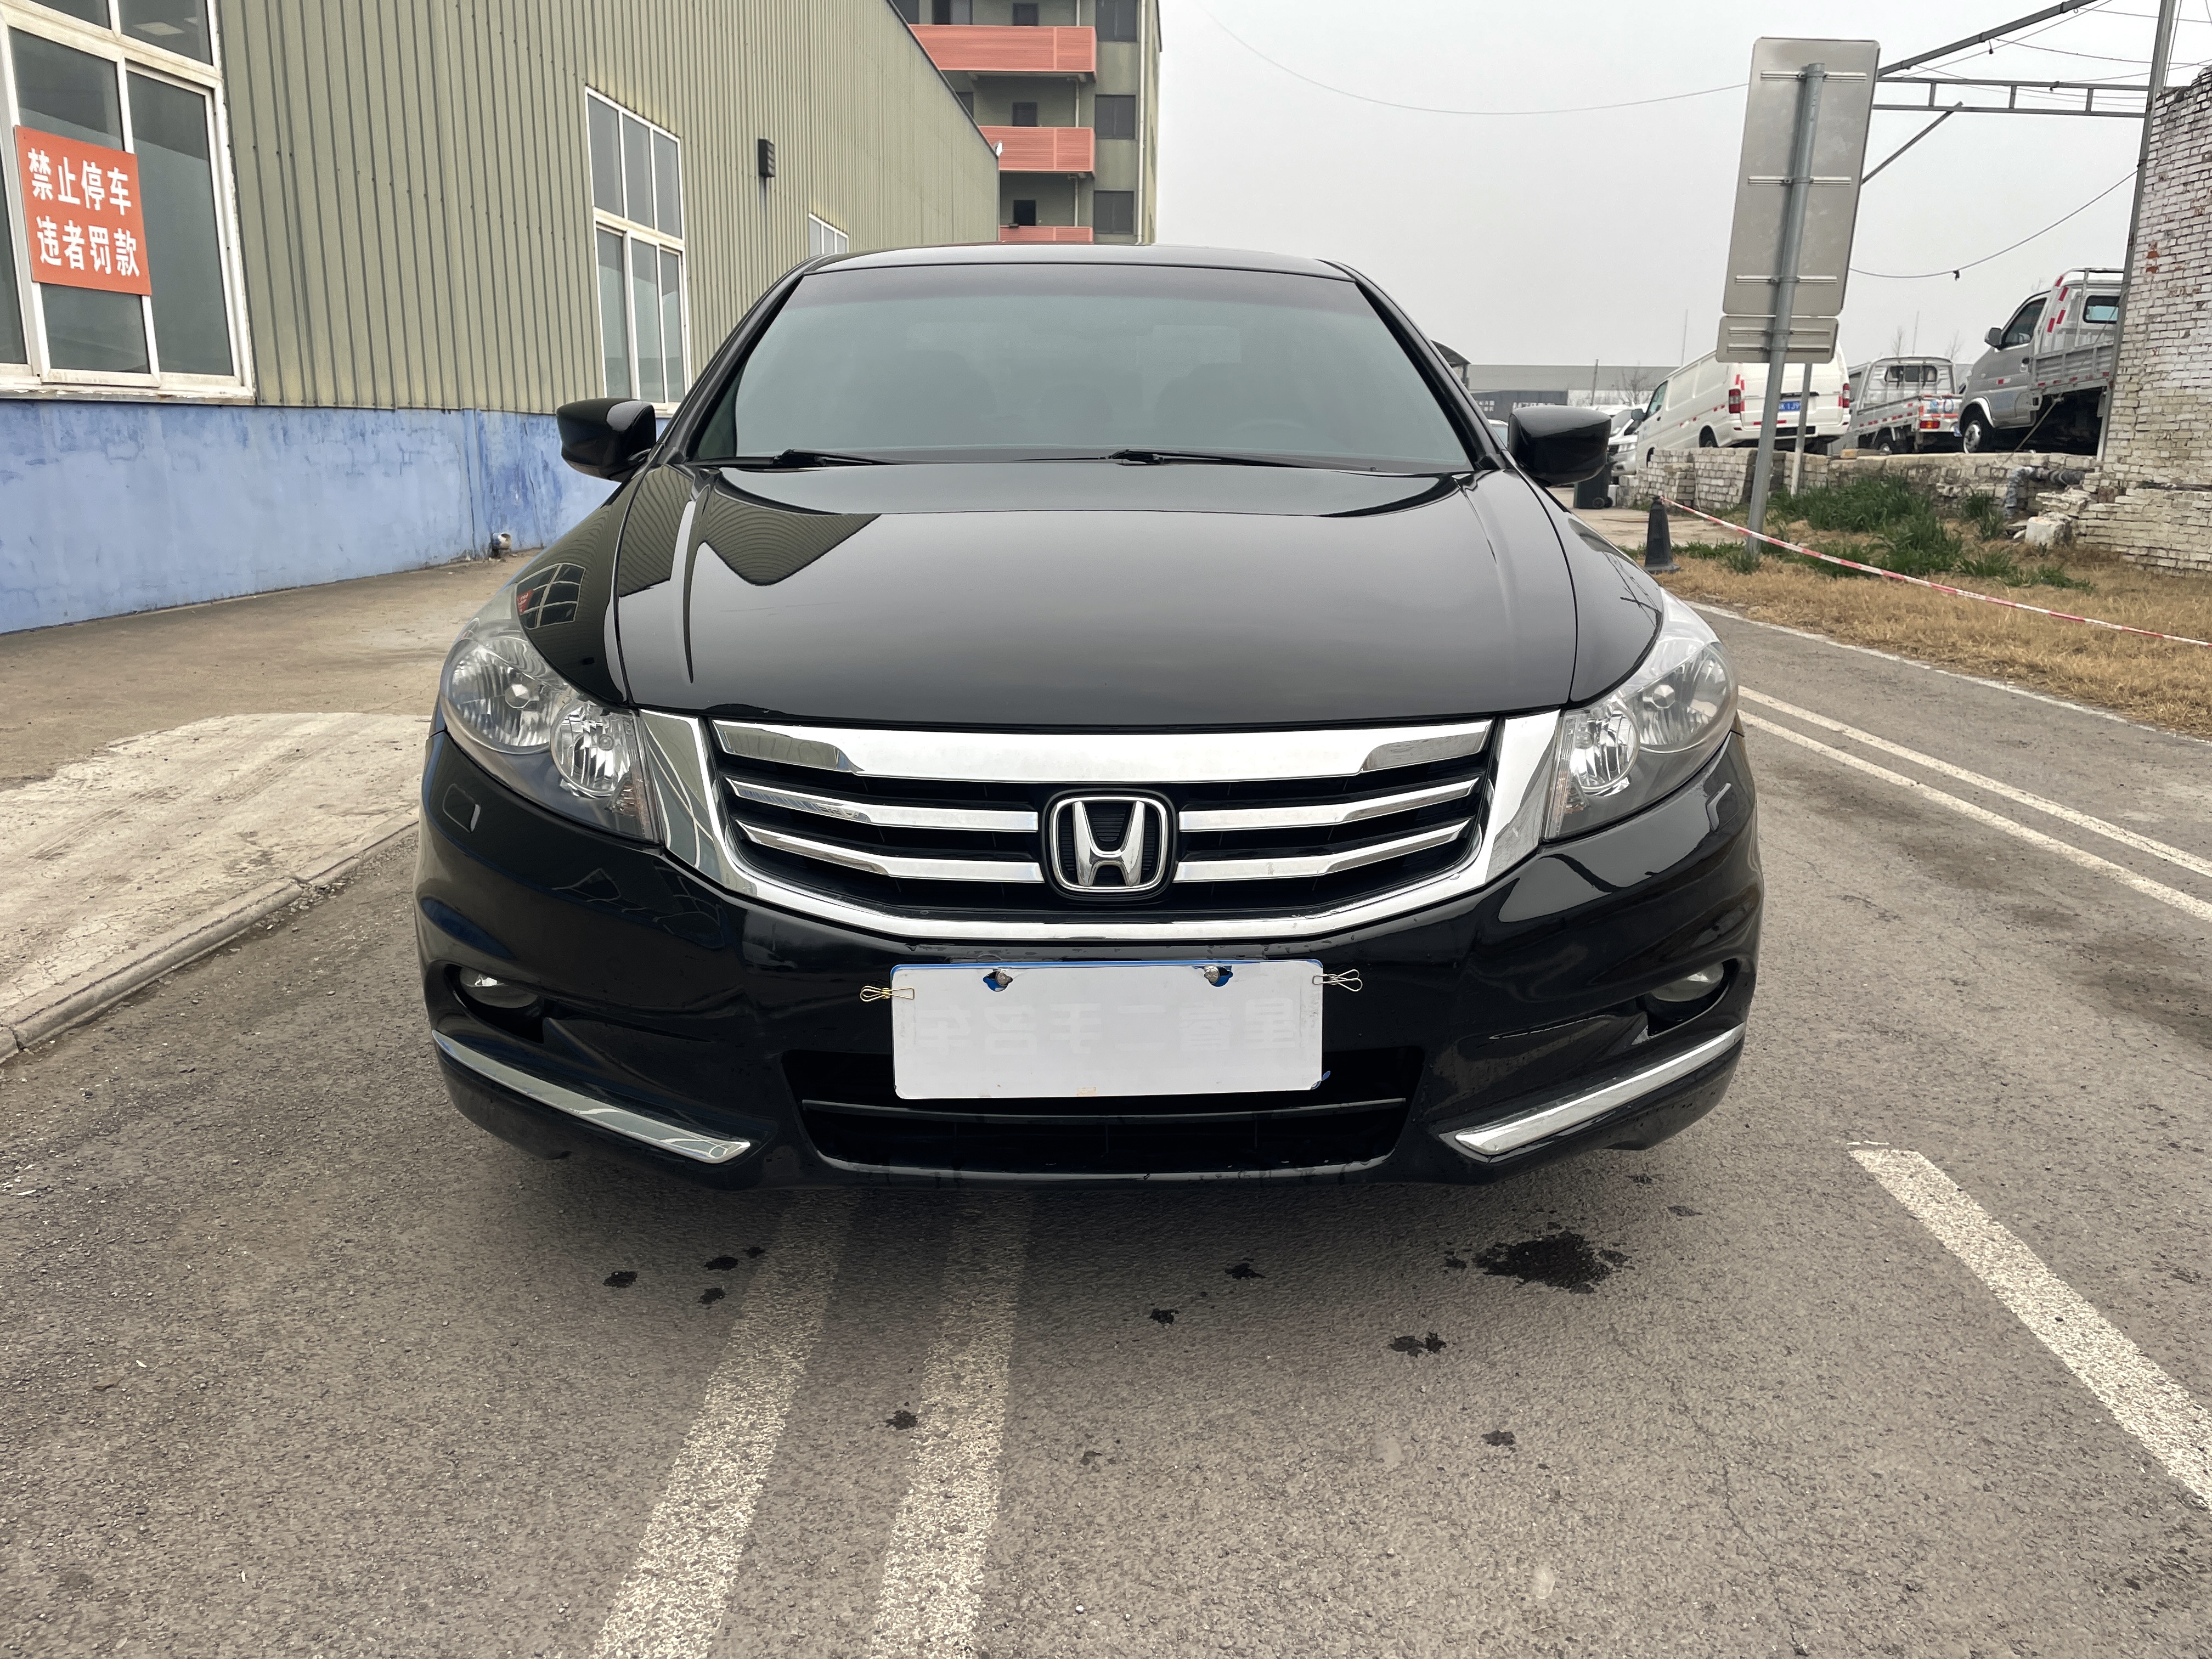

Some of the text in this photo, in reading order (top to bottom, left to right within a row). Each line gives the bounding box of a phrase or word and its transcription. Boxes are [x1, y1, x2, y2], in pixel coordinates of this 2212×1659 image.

[27, 148, 132, 216] 禁止停车
[36, 216, 140, 277] 违者罚款
